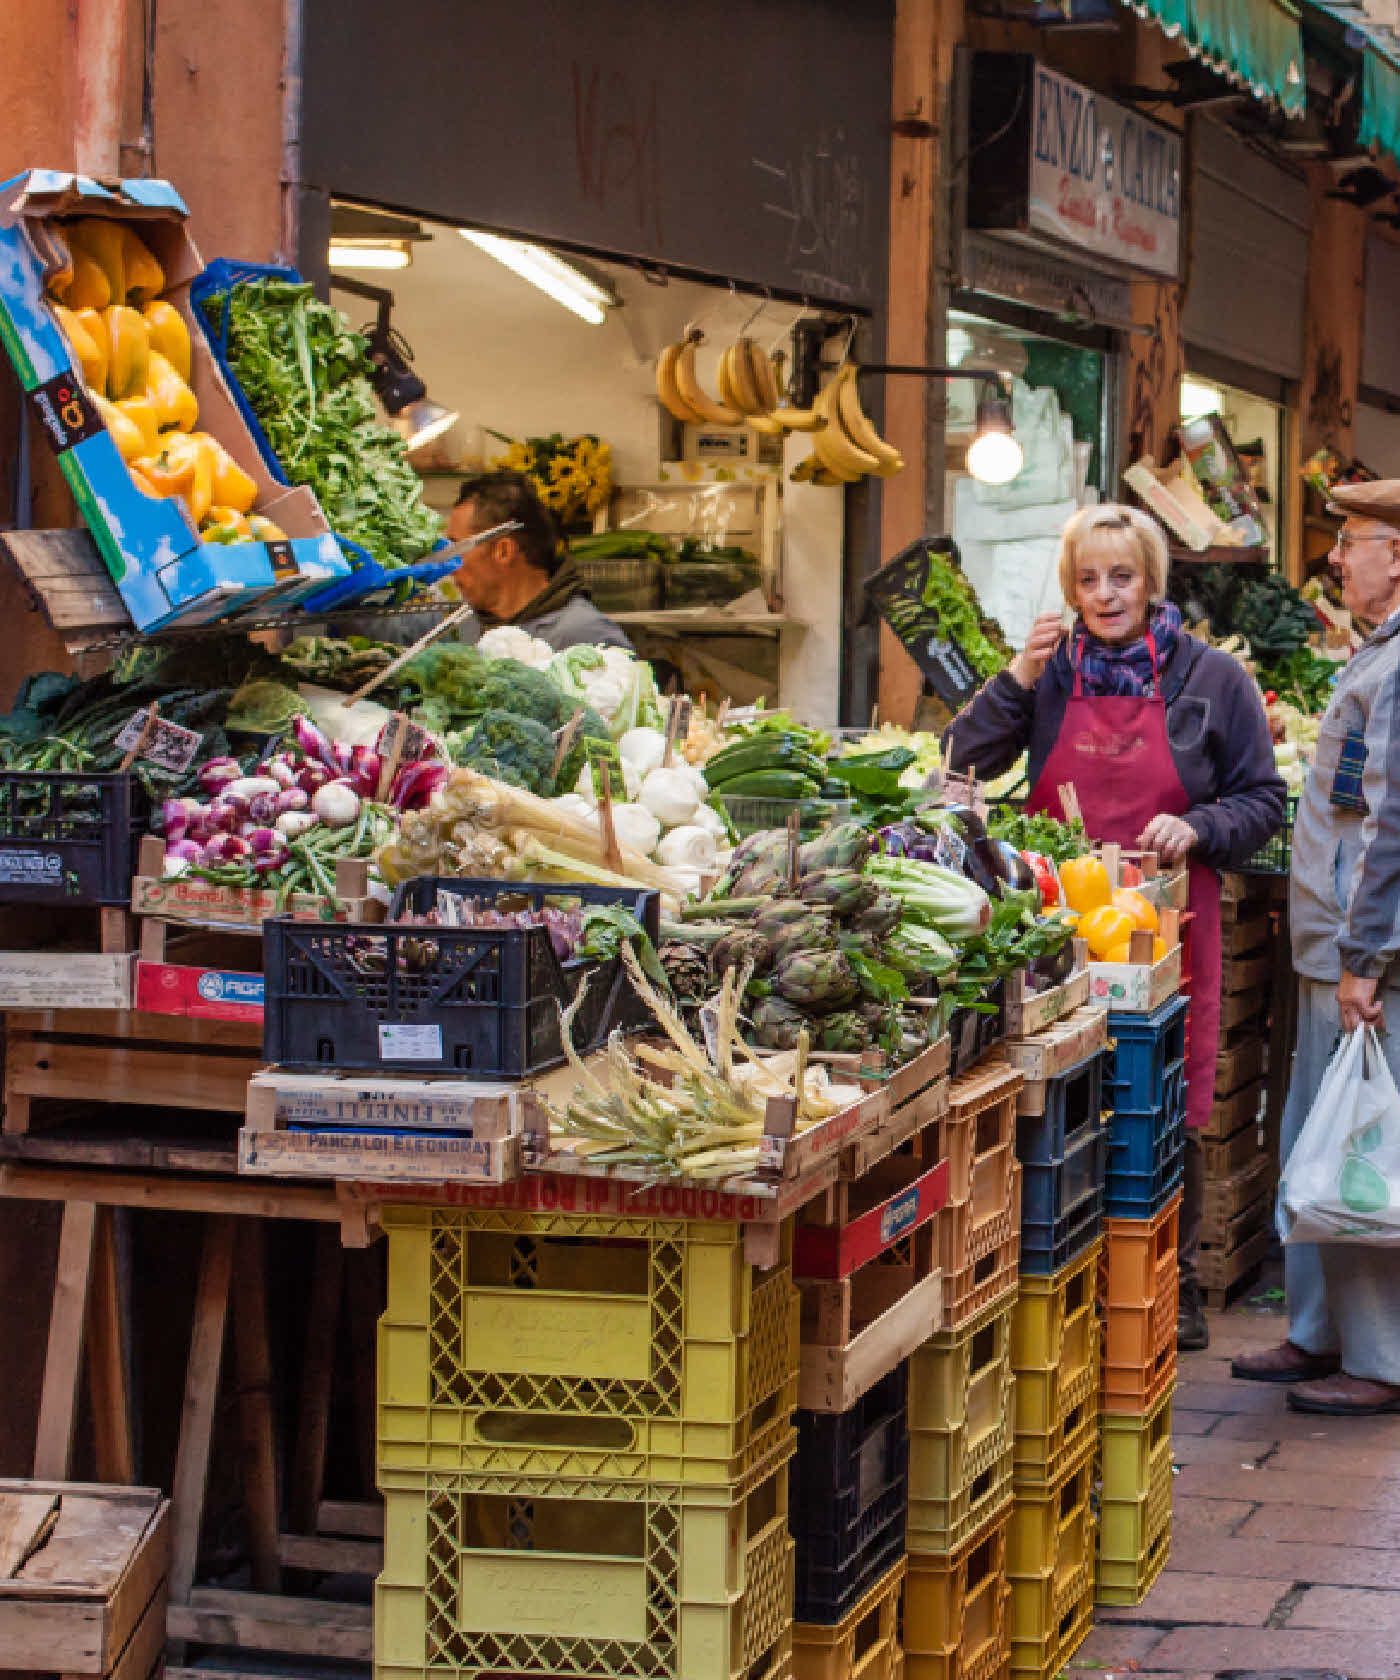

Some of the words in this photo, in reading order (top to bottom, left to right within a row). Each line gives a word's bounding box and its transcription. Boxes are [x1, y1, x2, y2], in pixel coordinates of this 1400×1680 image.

[1035, 72, 1097, 181] ENZO
[336, 1102, 433, 1122] FINELLI
[309, 1134, 388, 1151] PANCALDI
